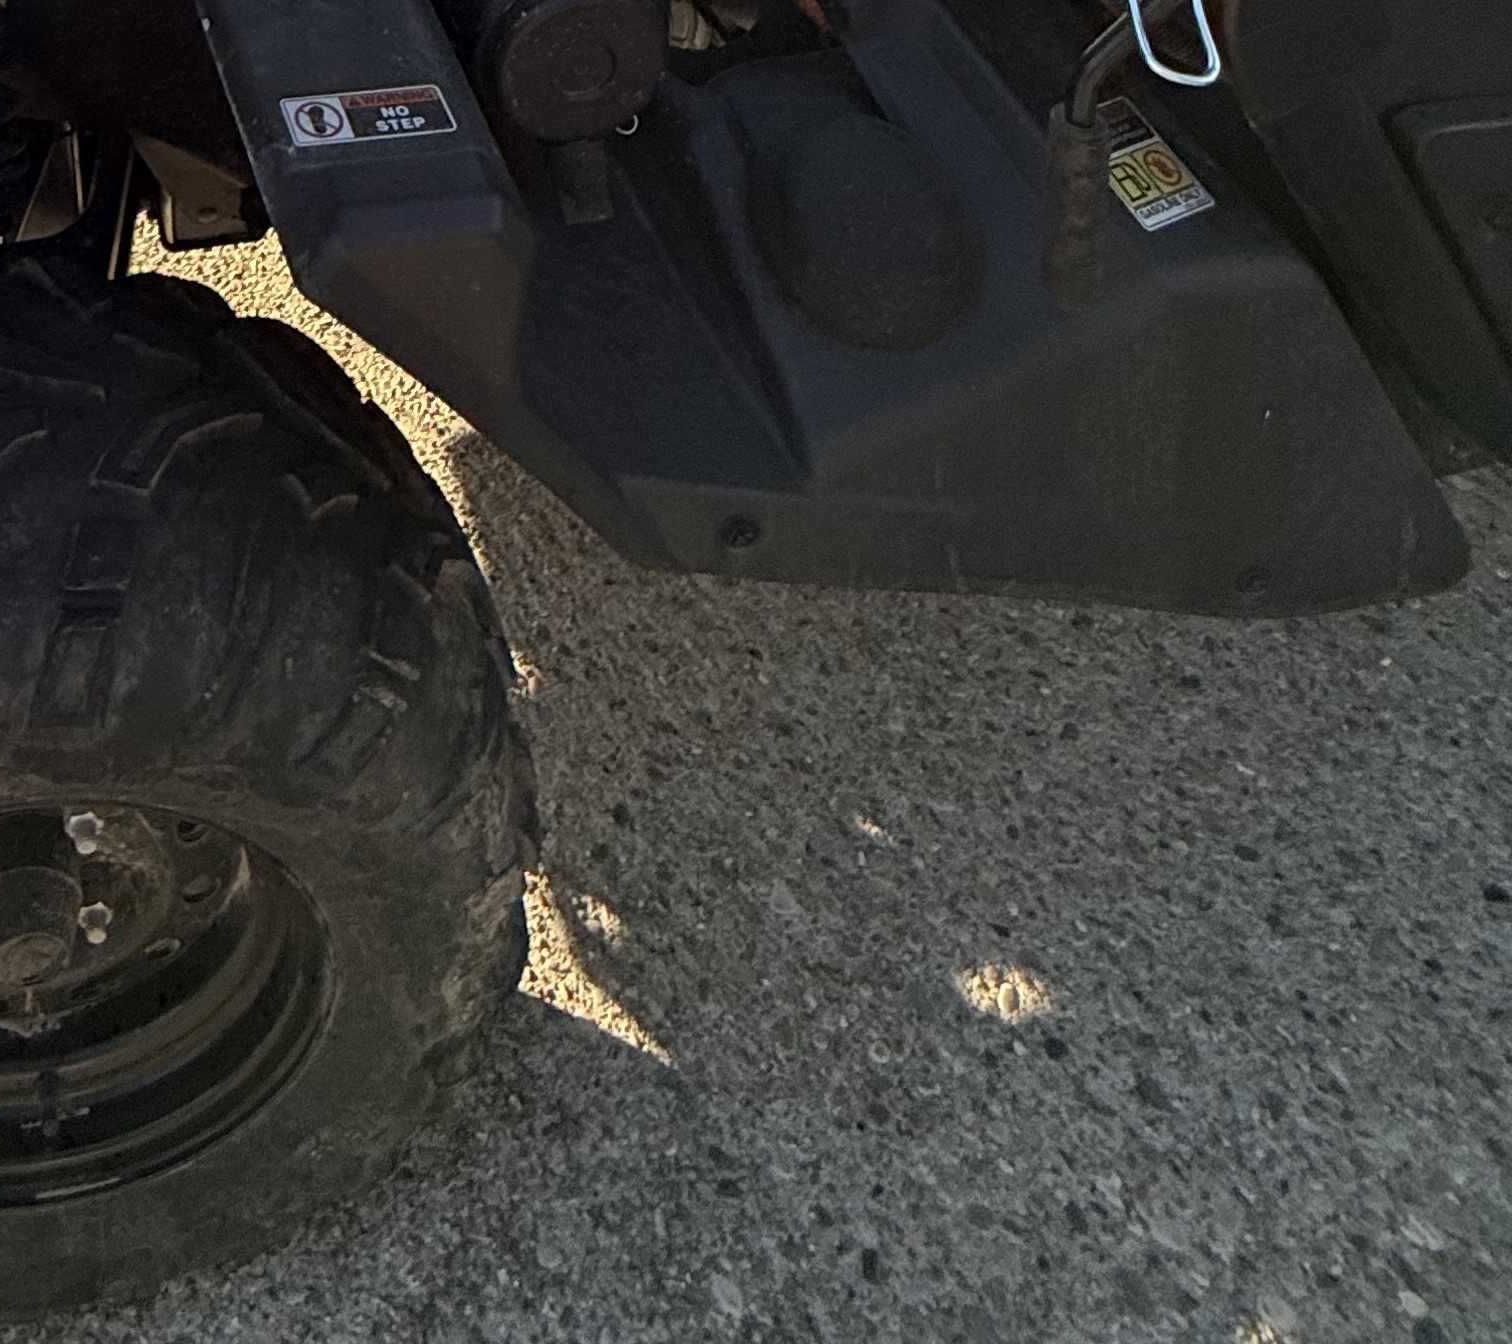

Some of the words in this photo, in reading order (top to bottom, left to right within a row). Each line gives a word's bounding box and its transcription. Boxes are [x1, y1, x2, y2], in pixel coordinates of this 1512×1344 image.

[363, 89, 433, 105] WARNING
[380, 105, 410, 118] NO
[375, 116, 426, 132] STEP
